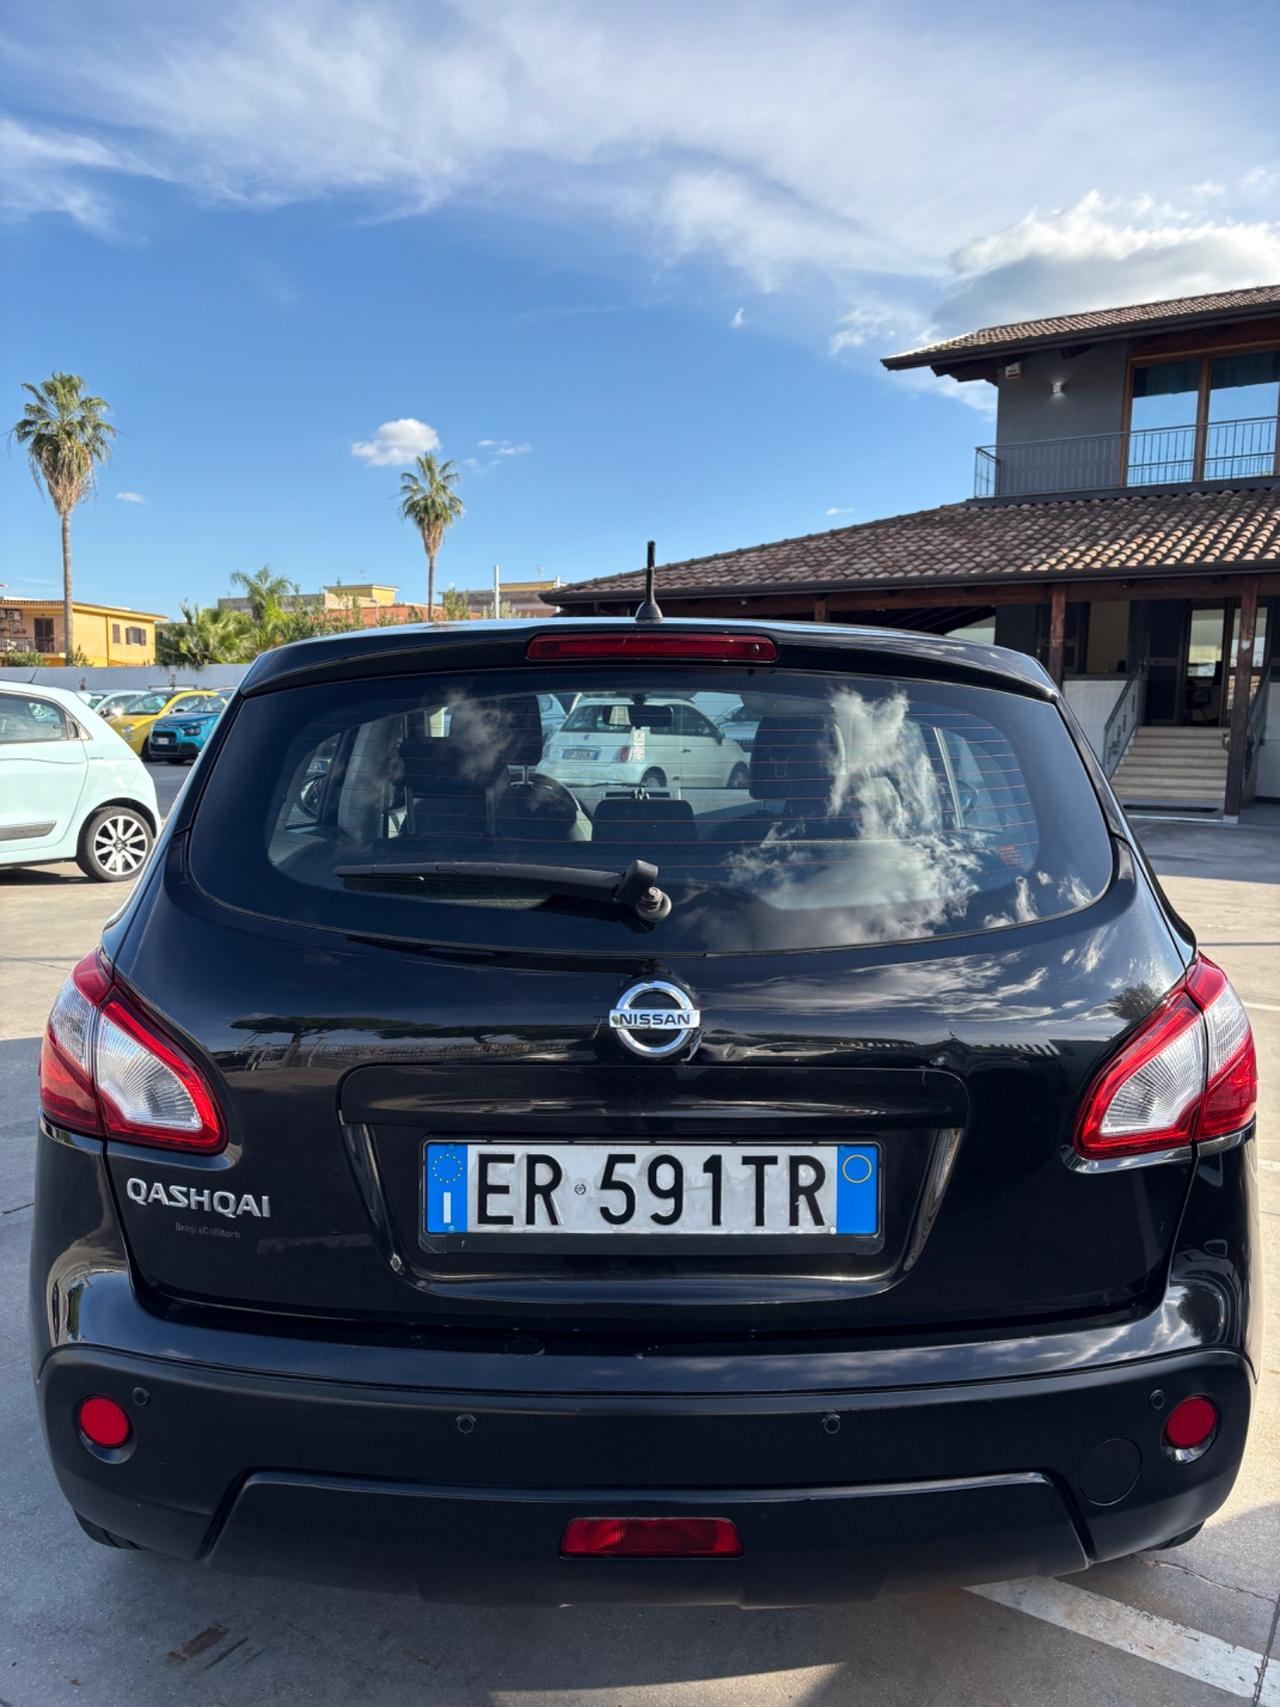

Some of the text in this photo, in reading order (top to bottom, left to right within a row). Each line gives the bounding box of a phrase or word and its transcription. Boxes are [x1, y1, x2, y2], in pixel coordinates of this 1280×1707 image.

[619, 1013, 690, 1025] NISSAN
[126, 1177, 271, 1218] QASHQAI
[477, 1153, 826, 1227] ER 591TR
